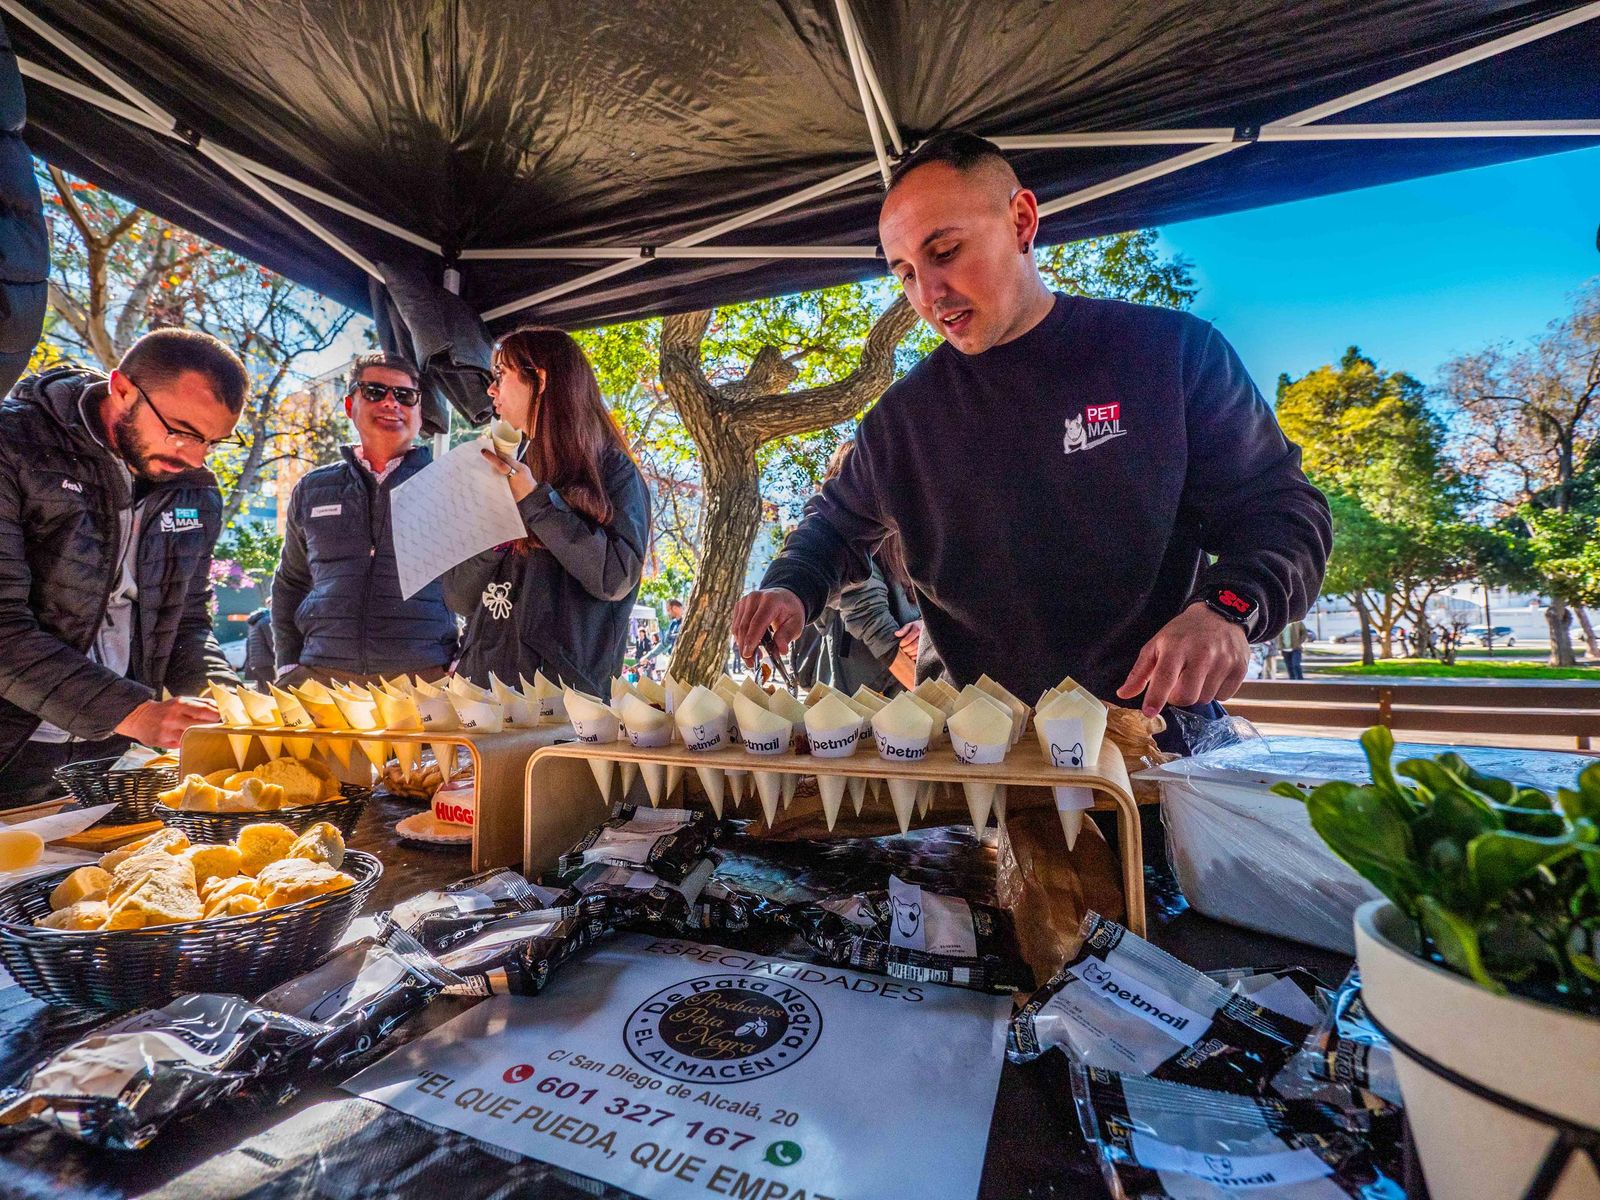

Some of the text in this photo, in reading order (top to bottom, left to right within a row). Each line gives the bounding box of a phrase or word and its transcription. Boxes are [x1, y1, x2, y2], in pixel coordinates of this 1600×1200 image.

[1087, 404, 1118, 421] PET
[1087, 419, 1127, 438] MAIL
[176, 509, 197, 518] PET
[176, 518, 203, 527] MAIL
[813, 728, 859, 751] petmail
[435, 801, 474, 825] HUGG
[645, 942, 925, 1003] ESPECIALIDADES
[643, 977, 812, 1050] De Pata Negra
[669, 1007, 726, 1028] Pata
[684, 992, 785, 1019] Productos
[1101, 980, 1190, 1031] petmail
[634, 1028, 776, 1079] EL ALMACÉN
[675, 1026, 758, 1060] Negra
[547, 1049, 799, 1128] C/ San Diego de Alcalá, 20
[536, 1076, 756, 1151] 601 327 167
[454, 1088, 521, 1119] QUE
[512, 1105, 618, 1159] PUEDA,
[630, 1142, 707, 1183] QUE
